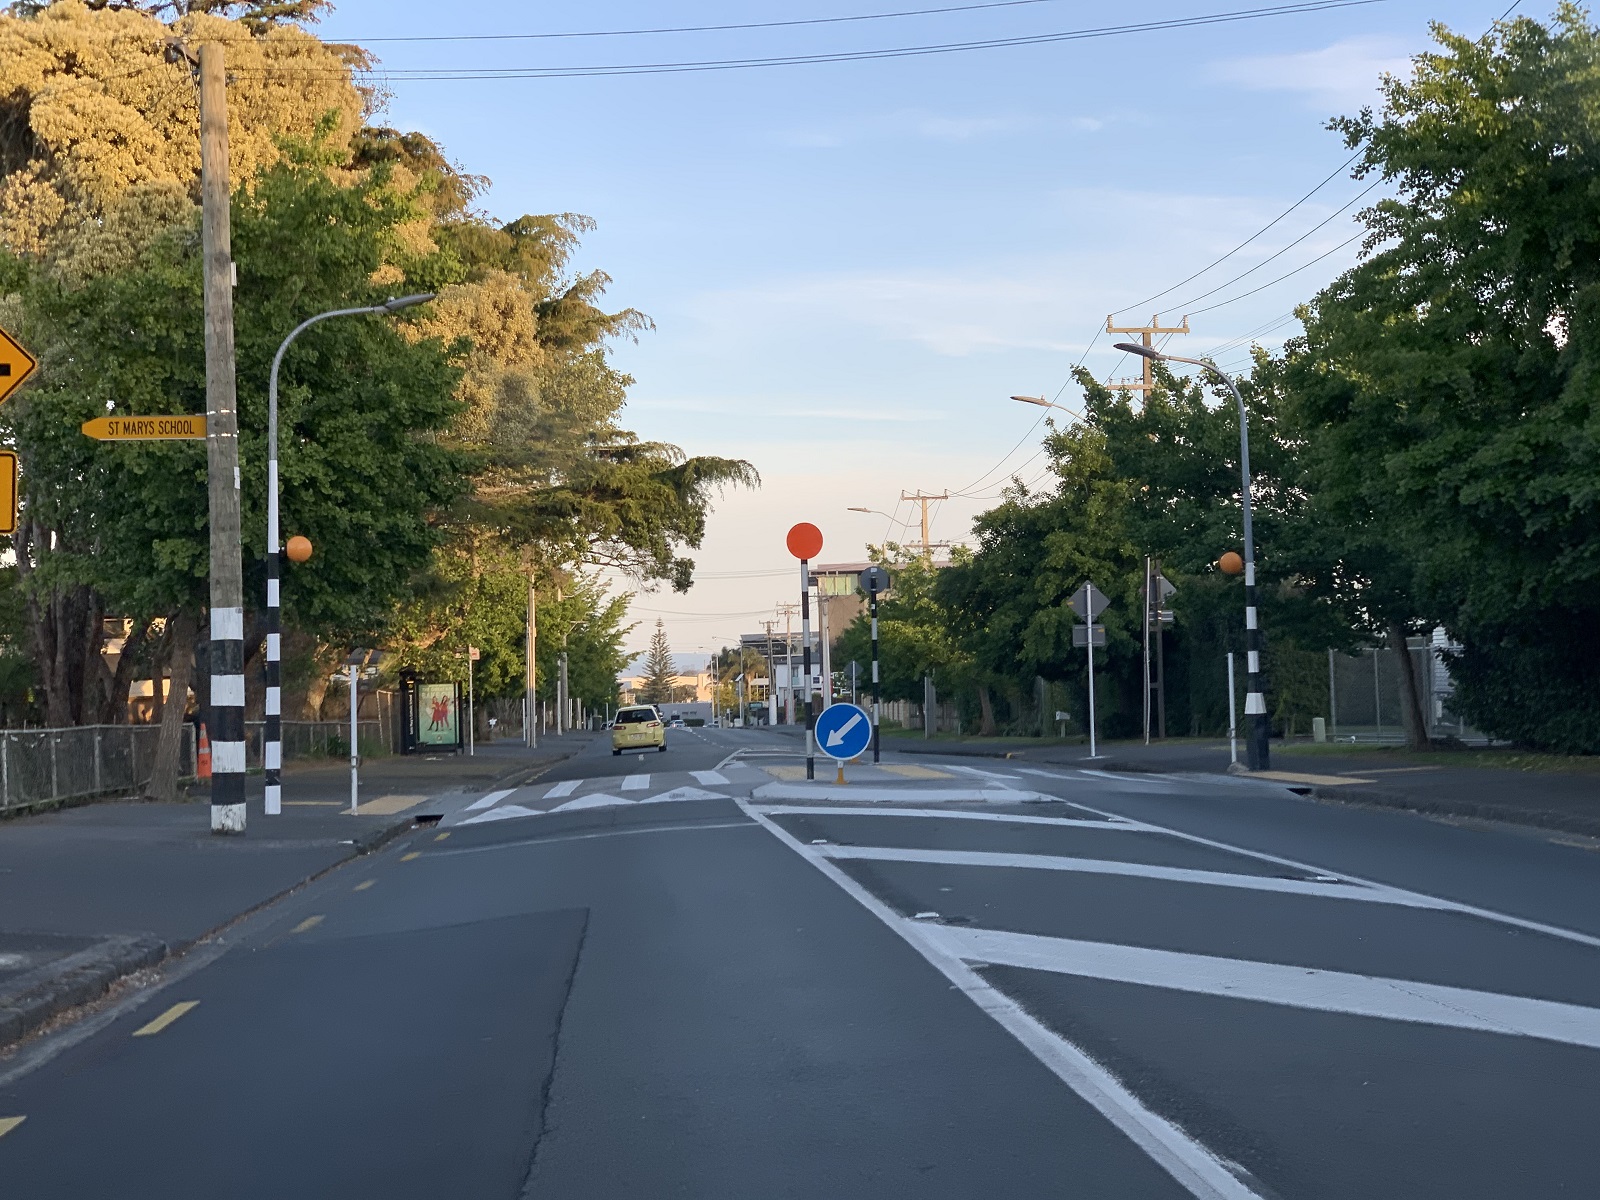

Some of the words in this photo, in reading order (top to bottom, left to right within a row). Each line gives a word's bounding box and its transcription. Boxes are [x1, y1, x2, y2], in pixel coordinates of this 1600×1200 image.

[108, 421, 120, 436] ST
[123, 420, 155, 435] MARYS
[158, 420, 195, 435] SCHOOL
